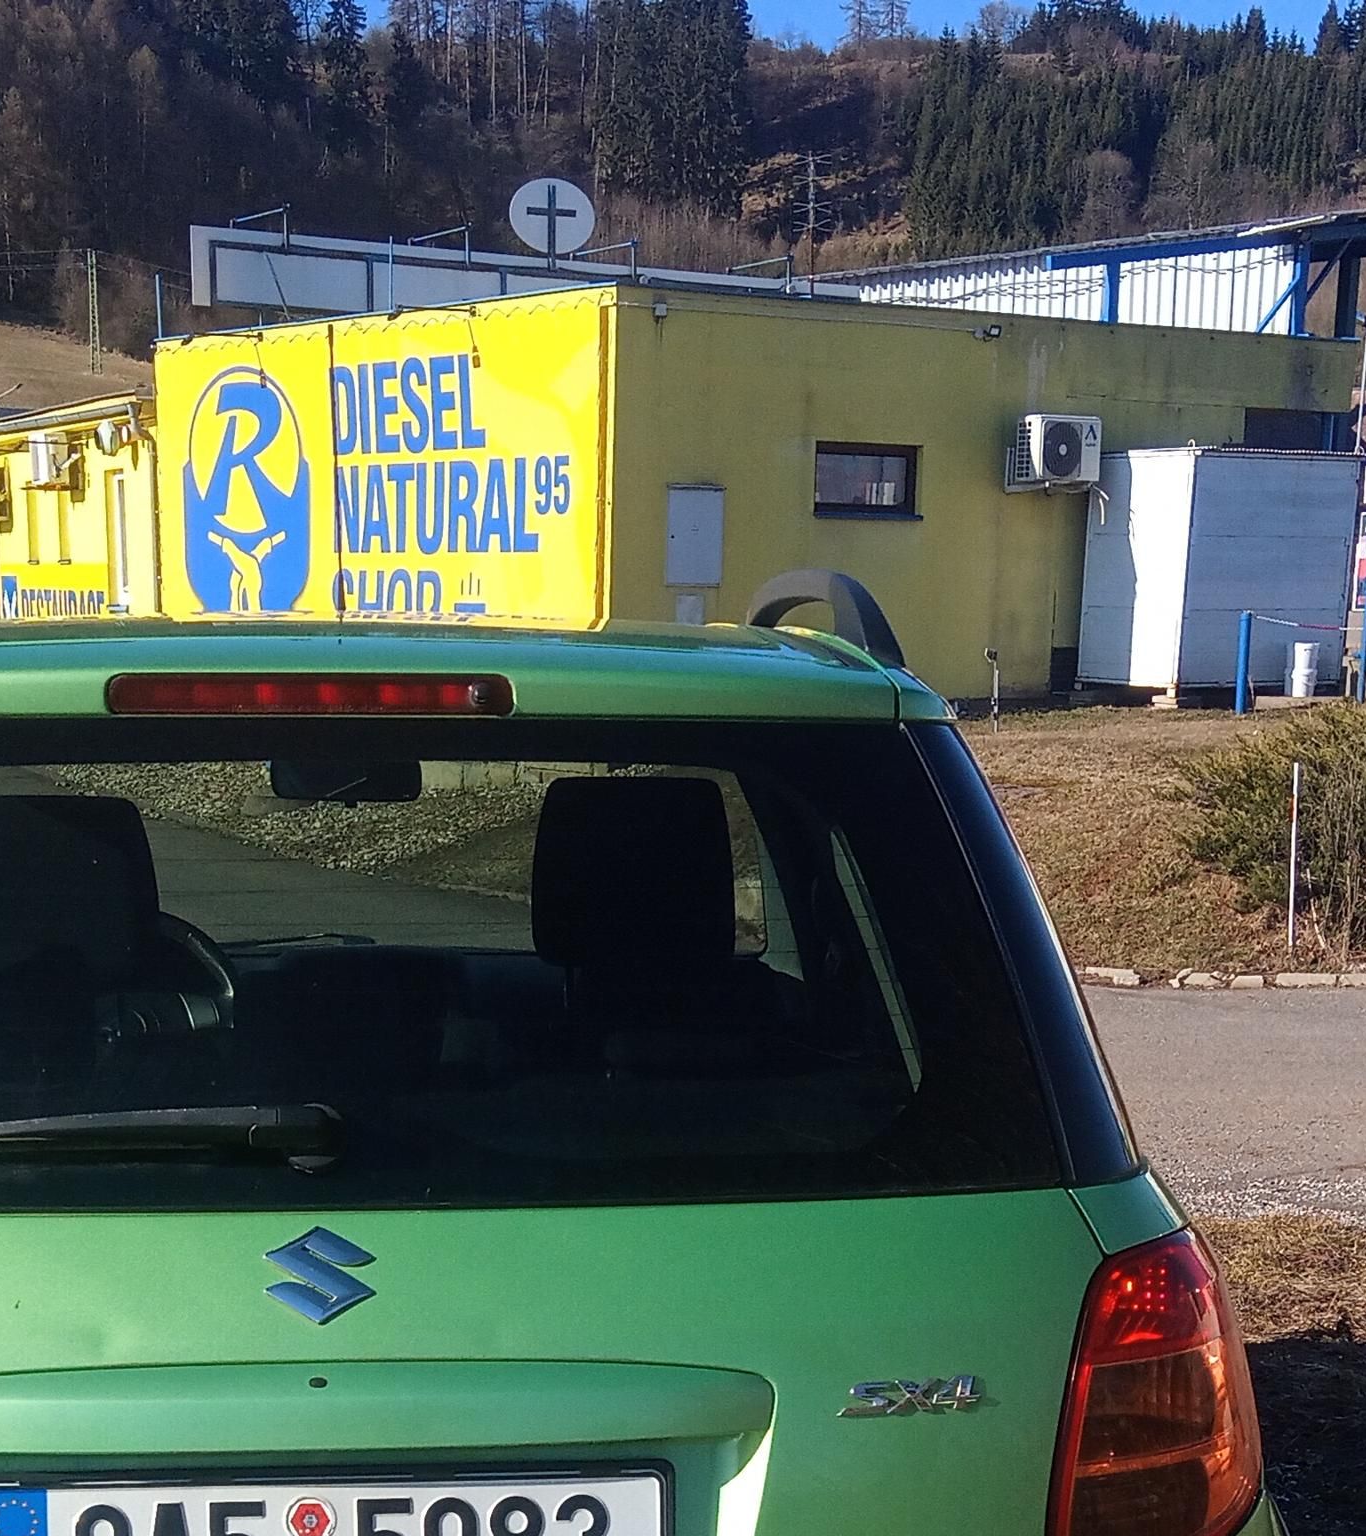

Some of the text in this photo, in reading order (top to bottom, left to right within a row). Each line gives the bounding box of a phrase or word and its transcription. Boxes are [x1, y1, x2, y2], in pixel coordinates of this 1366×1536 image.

[329, 354, 485, 456] DIESEL
[332, 455, 570, 555] NATURAL 95
[837, 1374, 982, 1417] SX4
